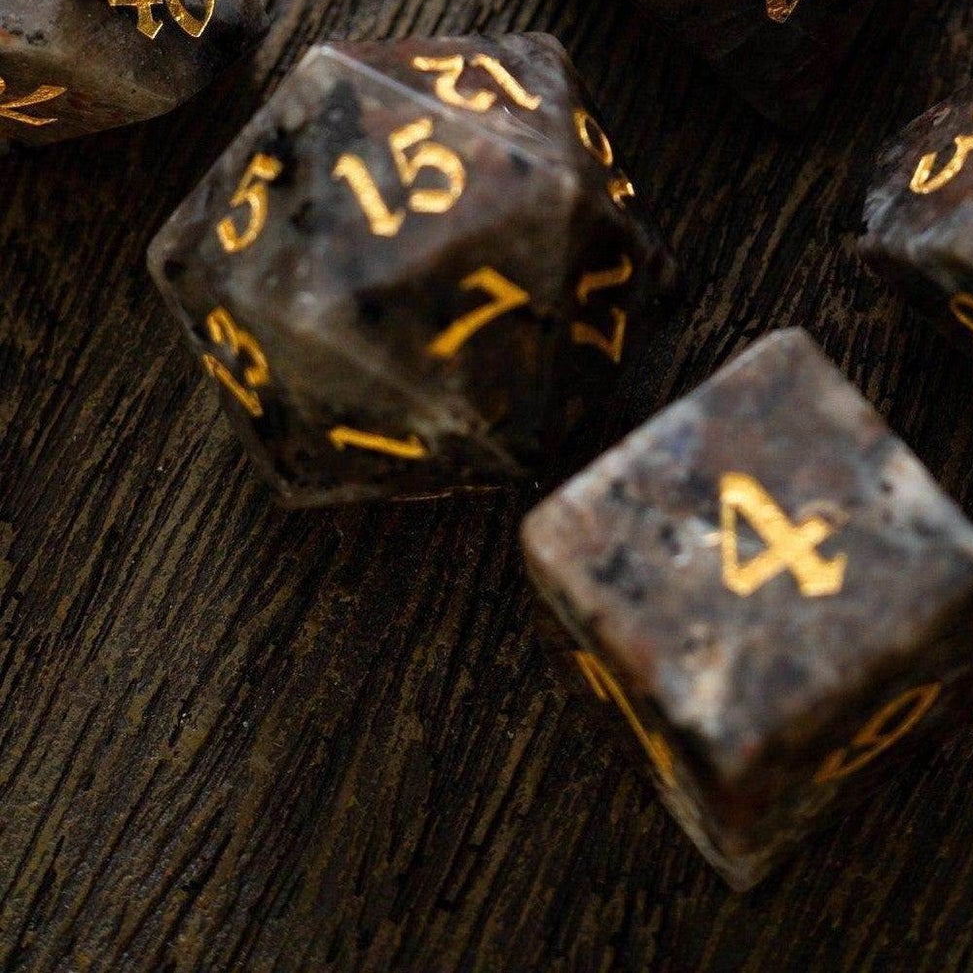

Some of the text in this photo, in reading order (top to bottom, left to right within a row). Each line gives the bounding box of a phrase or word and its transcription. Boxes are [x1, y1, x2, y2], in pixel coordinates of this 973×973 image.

[216, 153, 284, 255] 5
[331, 117, 467, 239] 15
[426, 266, 531, 360] 7
[718, 471, 849, 598] 4
